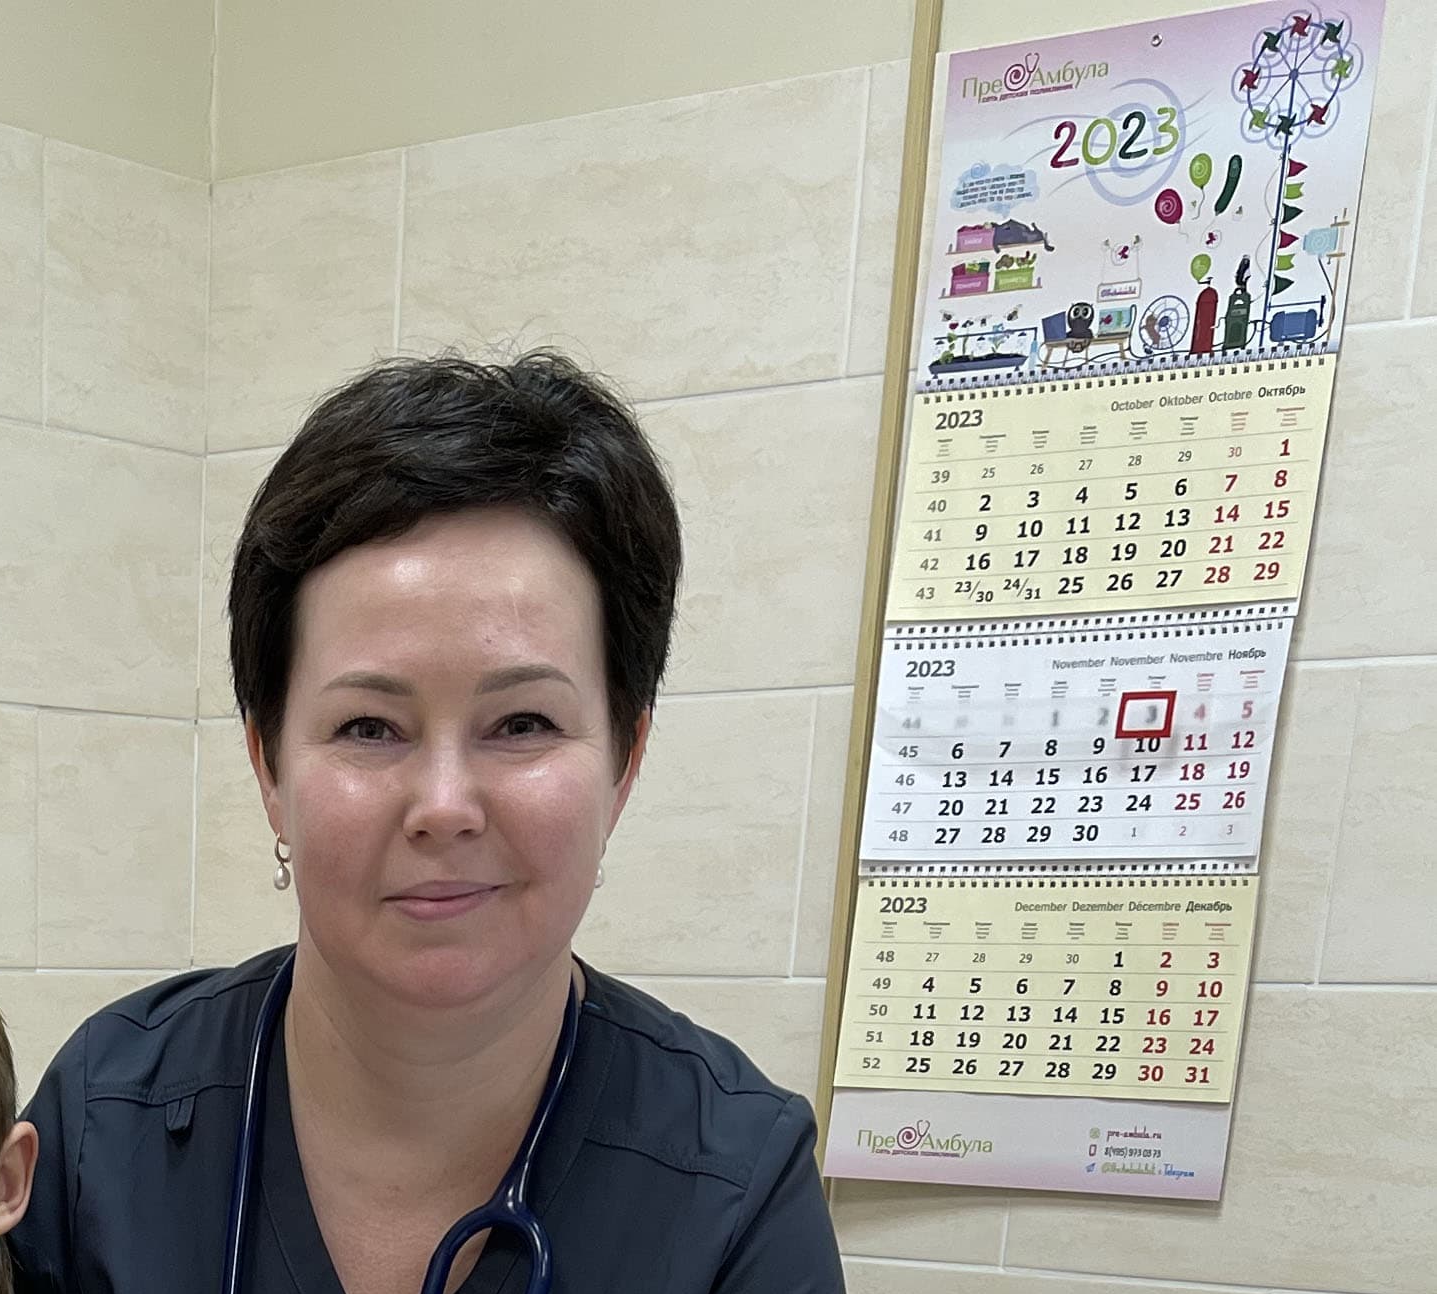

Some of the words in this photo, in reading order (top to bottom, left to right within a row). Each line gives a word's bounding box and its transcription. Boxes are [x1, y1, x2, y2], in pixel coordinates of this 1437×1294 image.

[1029, 60, 1109, 88] Амбула
[1050, 107, 1180, 169] 2023
[1111, 400, 1154, 412] October
[1159, 394, 1204, 408] Oktober
[1208, 391, 1253, 403] Octobre
[1258, 384, 1306, 399] Октябрь
[935, 409, 983, 430] 2023
[931, 470, 950, 484] 39
[981, 467, 996, 479] 25
[1030, 463, 1044, 475] 26
[1078, 459, 1093, 471] 27
[1128, 455, 1142, 467] 28
[1178, 450, 1192, 462] 29
[1228, 446, 1242, 458] 30
[1279, 438, 1290, 457] 1
[927, 499, 947, 512] 40
[979, 494, 991, 512] 2
[1027, 491, 1039, 508] 3
[1075, 487, 1088, 504] 4
[1125, 482, 1138, 500] 5
[1175, 478, 1187, 496] 6
[1225, 474, 1238, 492] 7
[1274, 470, 1287, 488] 8
[923, 528, 941, 542] 41
[975, 524, 987, 541] 9
[1017, 520, 1043, 538] 10
[1066, 516, 1090, 535] 11
[1115, 512, 1141, 531] 12
[1164, 509, 1190, 527] 13
[1214, 504, 1240, 523] 14
[1263, 500, 1290, 519] 15
[920, 558, 939, 571] 42
[965, 553, 990, 571] 16
[1014, 550, 1040, 568] 17
[1062, 546, 1088, 565] 18
[1111, 543, 1137, 561] 19
[1160, 539, 1186, 558] 20
[1208, 535, 1233, 554] 21
[1258, 531, 1285, 550] 22
[915, 587, 935, 600] 43
[1058, 576, 1084, 594] 25
[1106, 573, 1133, 591] 26
[1156, 569, 1183, 588] 27
[1204, 566, 1231, 584] 28
[1253, 562, 1280, 581] 29
[905, 660, 955, 678] 2023
[1052, 657, 1105, 669] November
[1110, 655, 1165, 666] November
[1169, 651, 1223, 664] Novembre
[1228, 647, 1267, 660] Ноябрь
[898, 745, 919, 758] 45
[952, 743, 964, 759] 6
[999, 741, 1011, 758] 7
[1045, 739, 1058, 756] 8
[1093, 737, 1105, 755] 9
[1133, 737, 1162, 753] 10
[1184, 733, 1207, 751] 11
[1231, 731, 1254, 749] 12
[895, 774, 915, 786] 46
[942, 771, 967, 788] 13
[989, 770, 1013, 786] 14
[1036, 768, 1060, 785] 15
[1083, 766, 1108, 784] 16
[1130, 765, 1157, 782] 17
[1179, 763, 1205, 781] 18
[1227, 761, 1250, 779] 19
[891, 802, 912, 814] 47
[938, 800, 963, 816] 20
[985, 798, 1008, 815] 21
[1031, 797, 1056, 814] 22
[1077, 796, 1103, 813] 23
[1126, 794, 1151, 811] 24
[1174, 793, 1201, 810] 25
[1222, 791, 1245, 809] 26
[888, 830, 908, 842] 48
[934, 828, 960, 844] 27
[981, 827, 1006, 843] 28
[1026, 826, 1051, 842] 29
[1072, 825, 1099, 841] 30
[1131, 826, 1137, 838] 1
[1178, 825, 1187, 837] 2
[1226, 824, 1234, 836] 3
[879, 897, 928, 914] 2023
[1014, 902, 1067, 912] December
[1072, 901, 1124, 911] Dezember
[1128, 901, 1181, 912] Décembre
[1185, 901, 1233, 913] Декабрь
[876, 950, 895, 963] 48
[925, 952, 940, 962] 27
[972, 953, 986, 963] 28
[1019, 953, 1033, 964] 29
[1066, 953, 1079, 964] 30
[1114, 951, 1124, 967] 1
[1160, 952, 1172, 968] 2
[1207, 952, 1220, 969] 3
[872, 977, 891, 989] 49
[922, 977, 935, 992] 4
[969, 978, 982, 993] 5
[1016, 978, 1028, 994] 6
[1063, 979, 1075, 995] 7
[1109, 979, 1122, 996] 8
[1156, 980, 1168, 997] 9
[1197, 981, 1222, 998] 10
[869, 1004, 888, 1016] 50
[913, 1004, 936, 1019] 11
[960, 1005, 984, 1021] 12
[1007, 1006, 1031, 1022] 13
[1053, 1006, 1077, 1023] 14
[1100, 1008, 1125, 1024] 15
[1146, 1009, 1171, 1025] 16
[1193, 1010, 1219, 1027] 17
[866, 1031, 883, 1043] 51
[910, 1030, 934, 1046] 18
[956, 1032, 981, 1048] 19
[1002, 1033, 1027, 1049] 20
[1049, 1034, 1072, 1051] 21
[1095, 1036, 1120, 1052] 22
[1142, 1037, 1167, 1054] 23
[1189, 1038, 1214, 1055] 24
[862, 1057, 880, 1069] 52
[906, 1057, 931, 1073] 25
[952, 1059, 977, 1075] 26
[998, 1060, 1024, 1076] 27
[1045, 1062, 1070, 1078] 28
[1092, 1063, 1116, 1080] 29
[1138, 1065, 1163, 1082] 30
[1185, 1066, 1209, 1083] 31
[920, 1133, 993, 1158] Амбула
